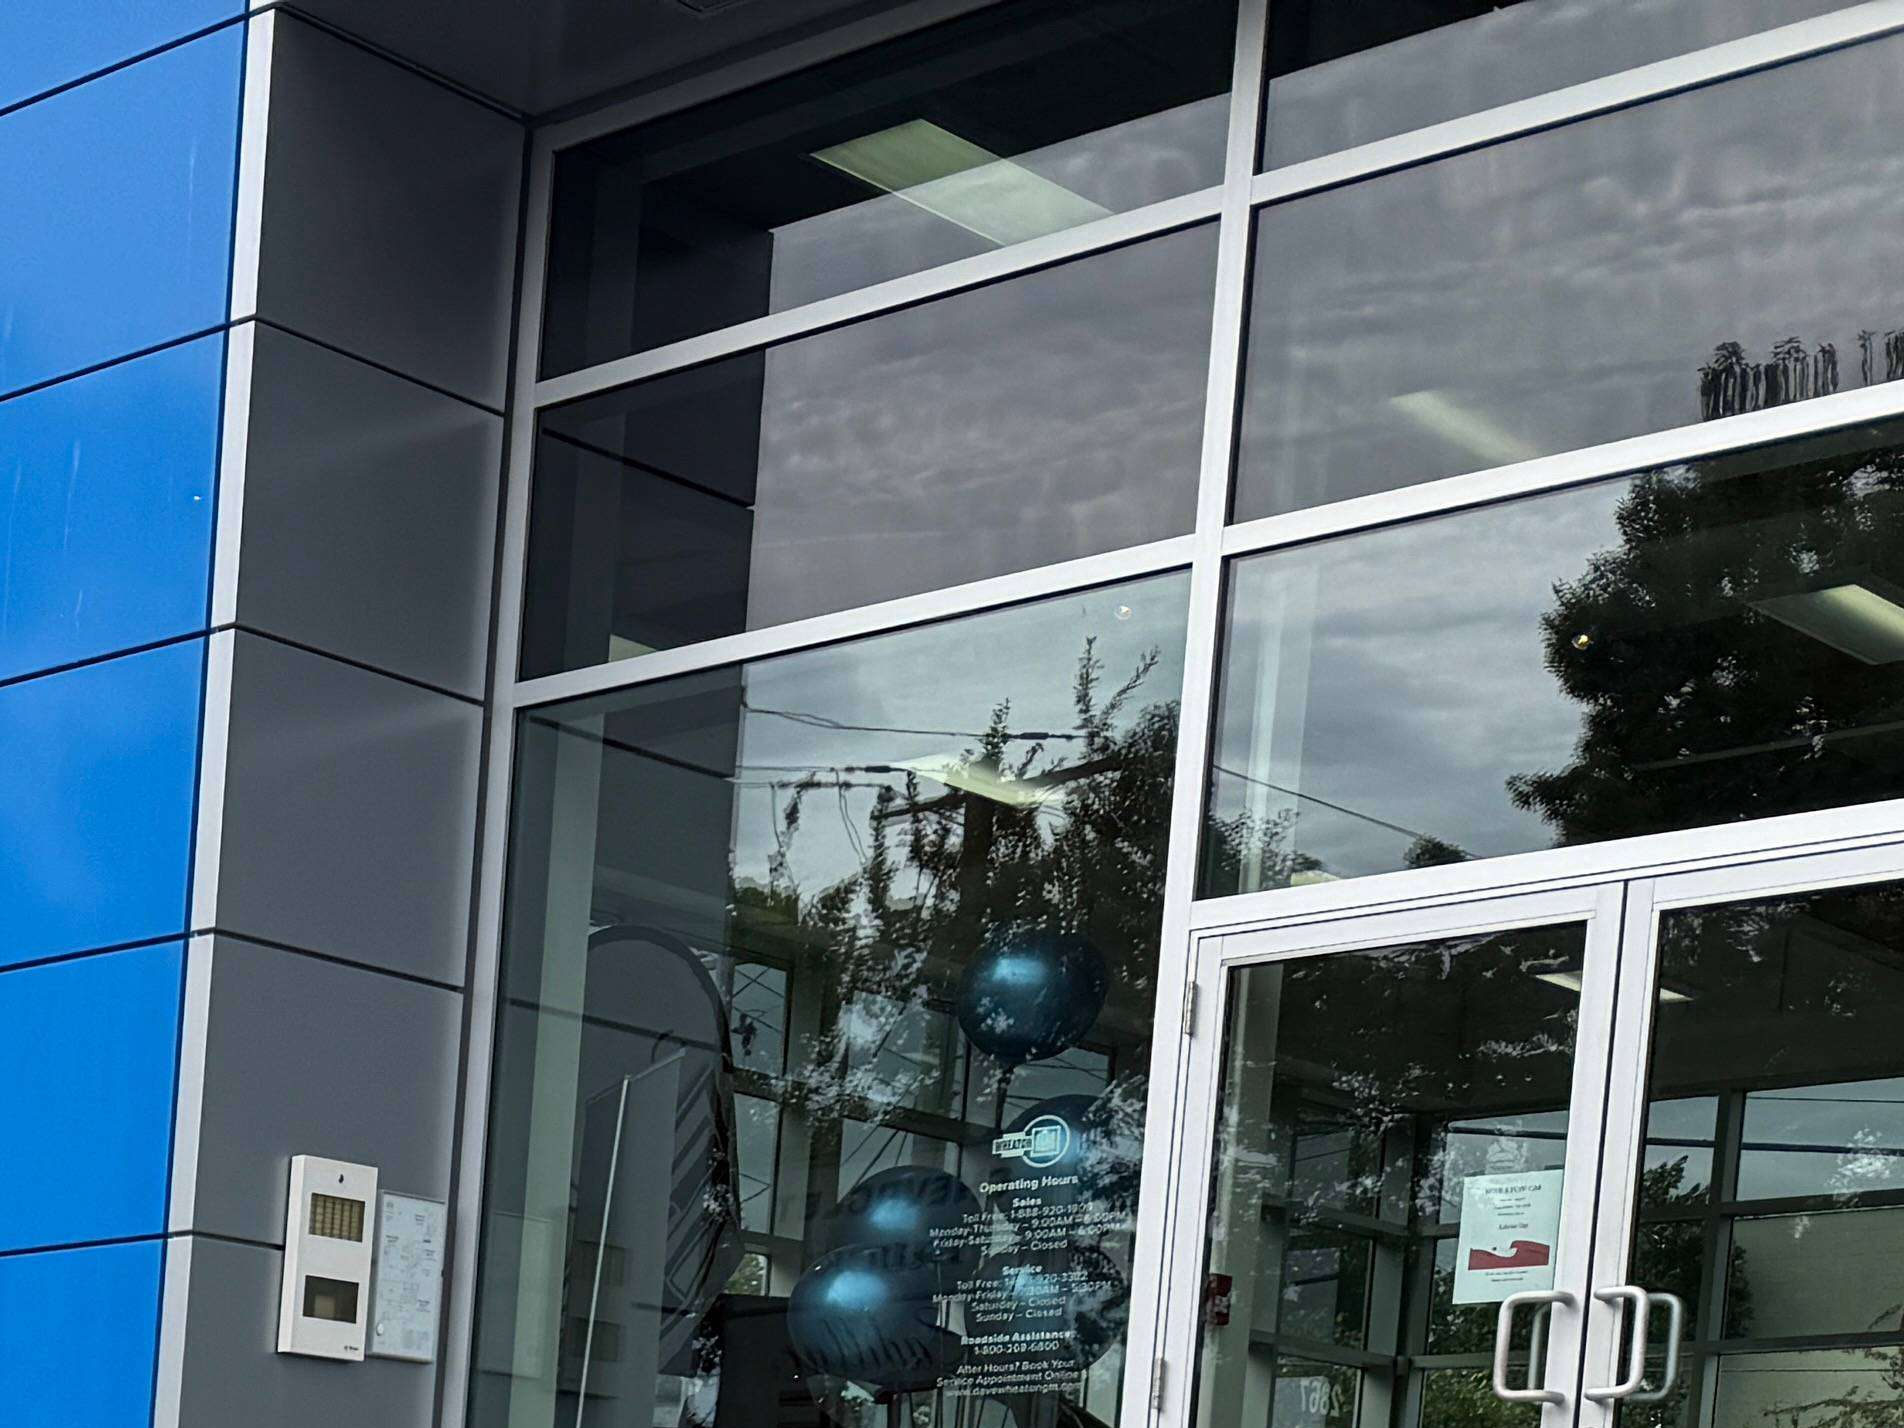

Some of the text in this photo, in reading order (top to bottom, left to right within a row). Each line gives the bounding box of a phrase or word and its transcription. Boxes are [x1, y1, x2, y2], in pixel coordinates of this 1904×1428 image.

[979, 1175, 1079, 1194] Operating Hours
[1013, 1197, 1042, 1207] Sales
